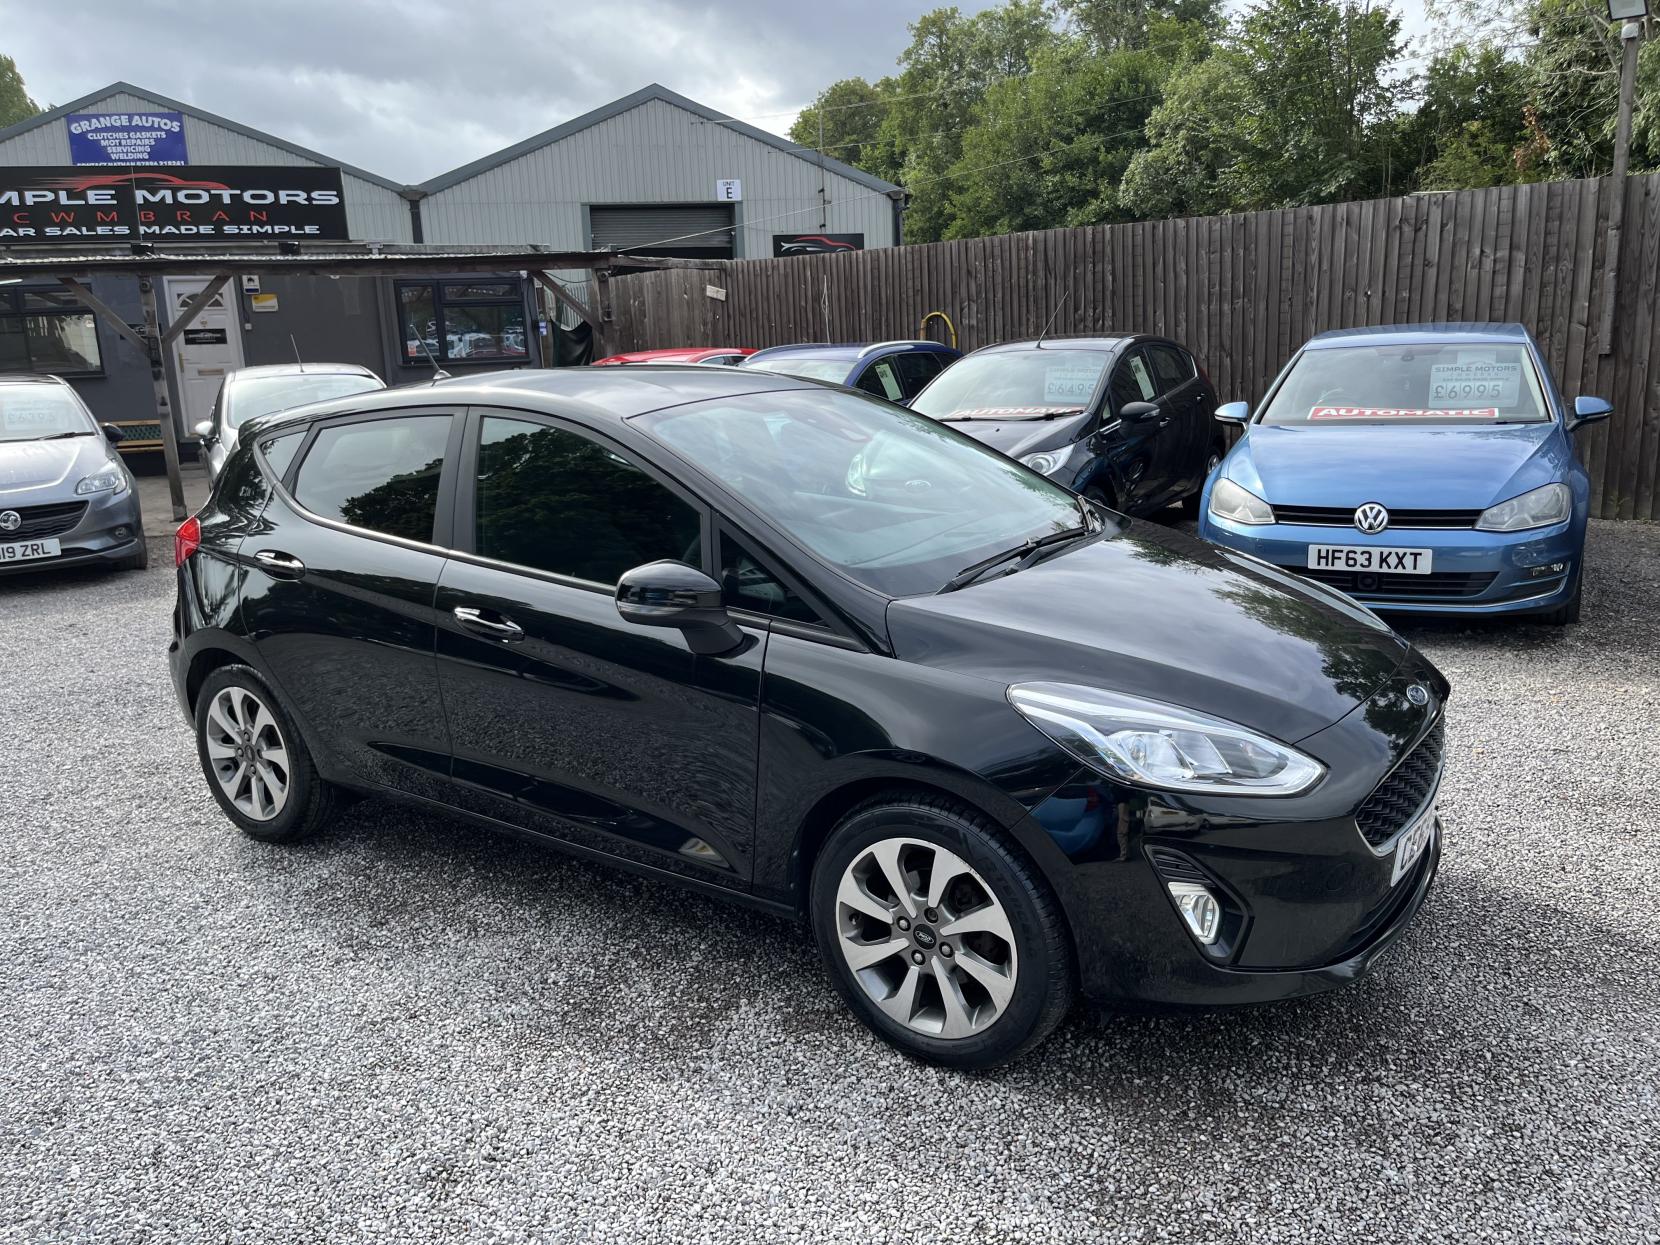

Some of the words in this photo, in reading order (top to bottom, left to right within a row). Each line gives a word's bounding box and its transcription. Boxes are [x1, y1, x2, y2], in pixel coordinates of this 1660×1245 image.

[70, 115, 129, 134] GRANGE
[131, 115, 180, 132] AUTOS
[100, 139, 120, 147] MOT
[121, 138, 155, 146] REPAIRS
[107, 145, 151, 153] SERVICING
[110, 152, 149, 160] WELDING
[135, 189, 340, 205] MOTORS
[726, 187, 733, 199] E
[44, 226, 131, 236] SALES
[139, 225, 215, 235] MADE
[223, 225, 321, 235] SIMPLE
[1433, 384, 1501, 400] £6995
[1317, 408, 1490, 417] AUTOMATIC
[0, 546, 16, 560] 19
[20, 542, 51, 558] ZRL
[1316, 548, 1373, 569] HF63
[1379, 550, 1423, 571] KXT
